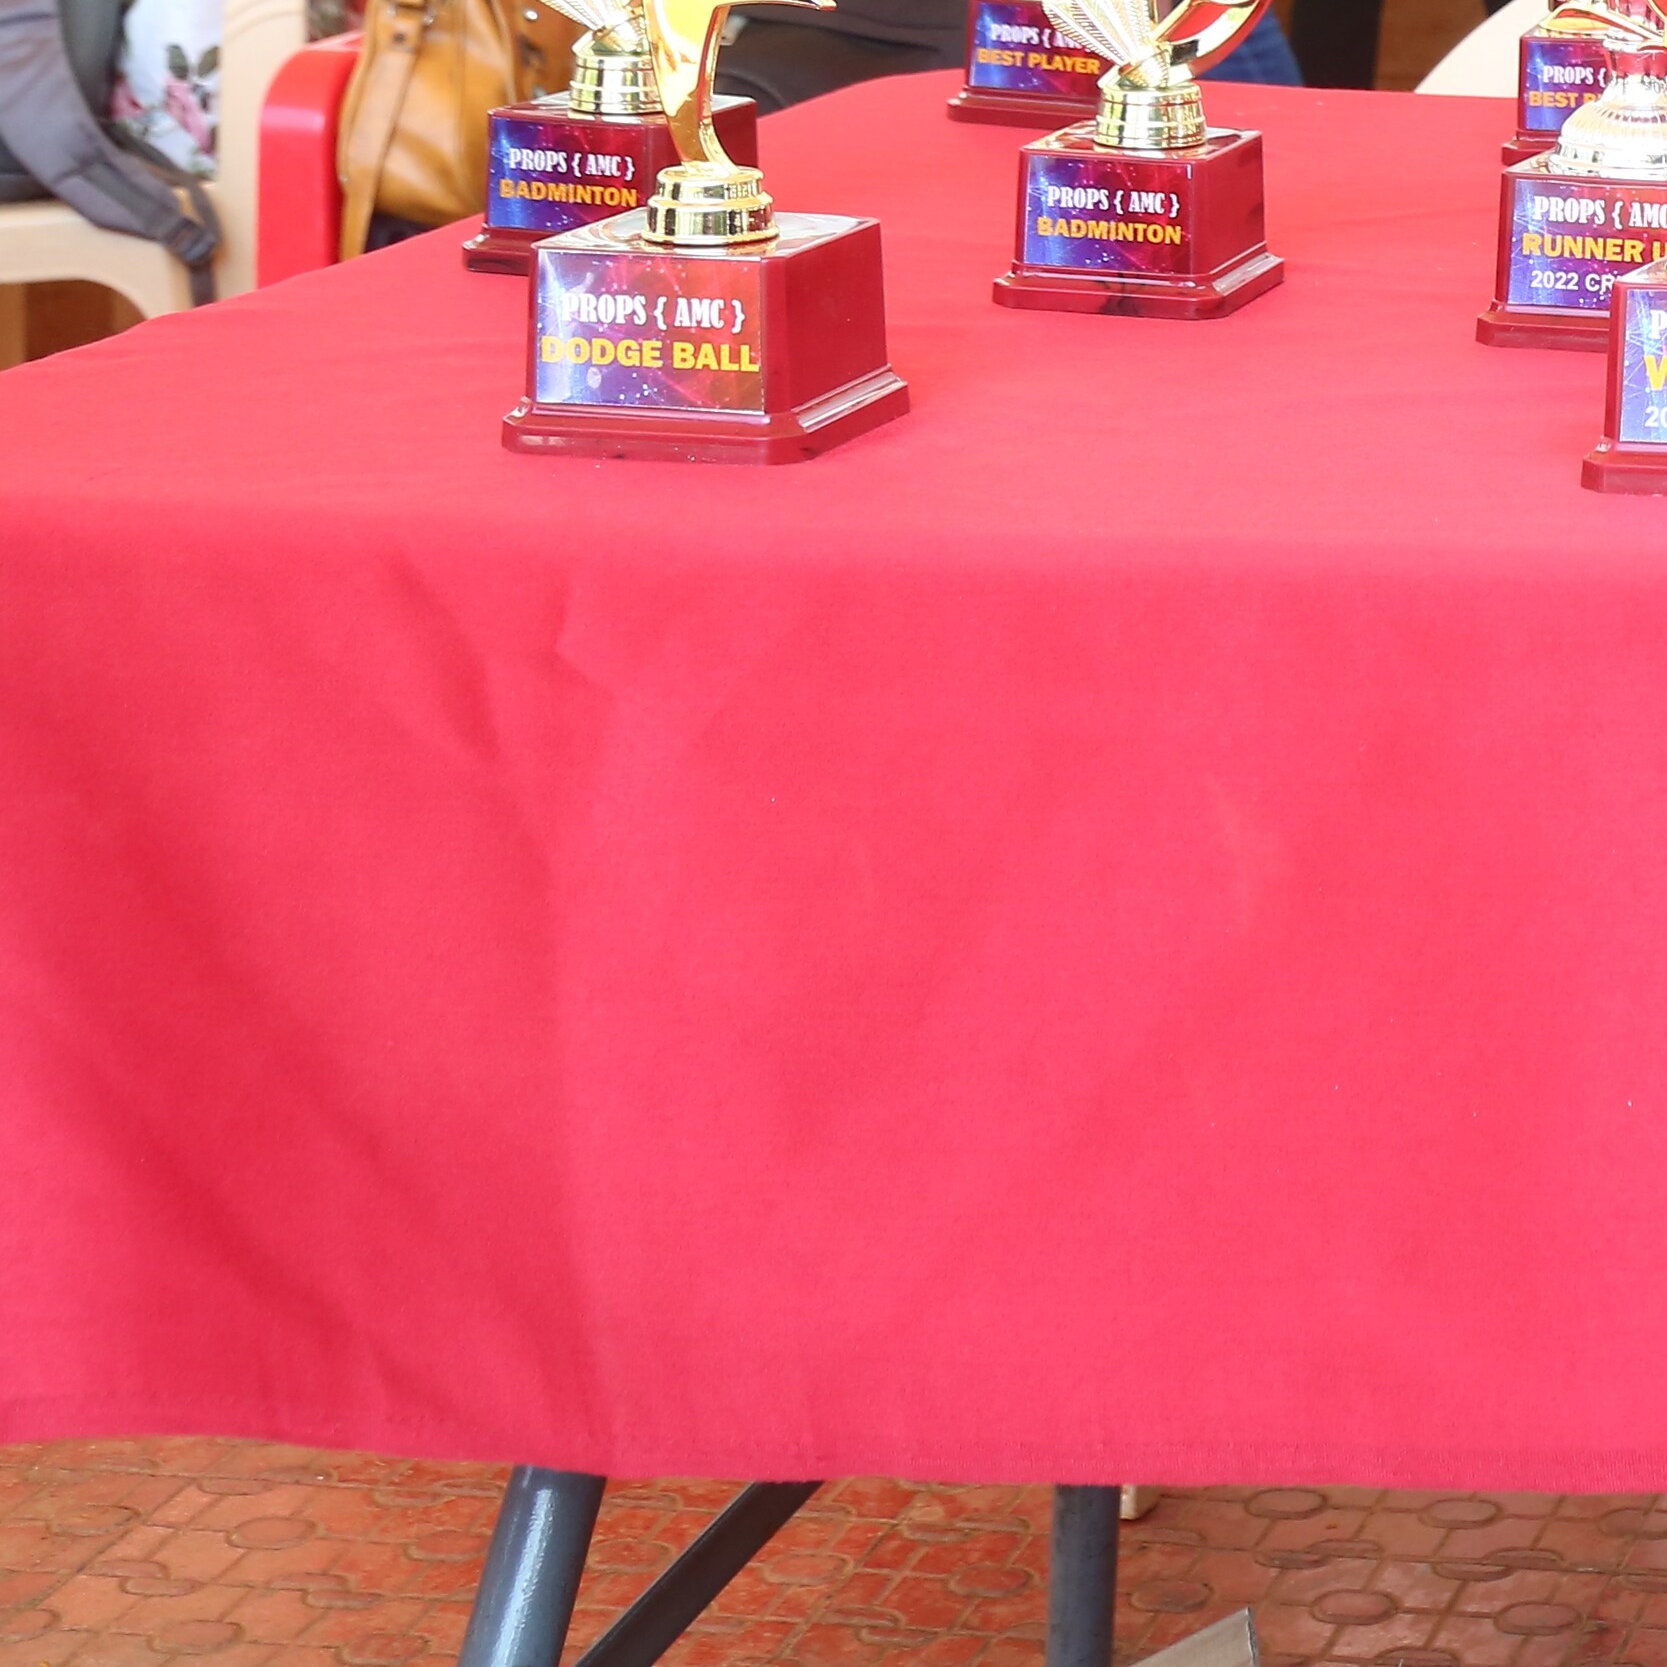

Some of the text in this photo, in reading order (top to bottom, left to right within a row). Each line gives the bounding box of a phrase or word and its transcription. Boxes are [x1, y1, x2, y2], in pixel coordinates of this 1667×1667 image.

[977, 47, 1101, 75] BEST PLAYER
[1543, 65, 1594, 85] PROPS
[1528, 91, 1578, 107] BEST
[509, 149, 568, 174] PROPS
[586, 152, 622, 176] AMC
[499, 178, 637, 208] BADMINTON
[1047, 186, 1109, 210] PROPS
[1129, 191, 1165, 214] AMC
[1534, 196, 1605, 225] PROPS
[1037, 217, 1181, 245] BADMINTON
[1522, 232, 1645, 263] RUNNER
[1531, 270, 1578, 290] 2022
[561, 294, 647, 326] PROPS
[674, 298, 725, 329] AMC
[541, 337, 760, 373] DODGE BALL
